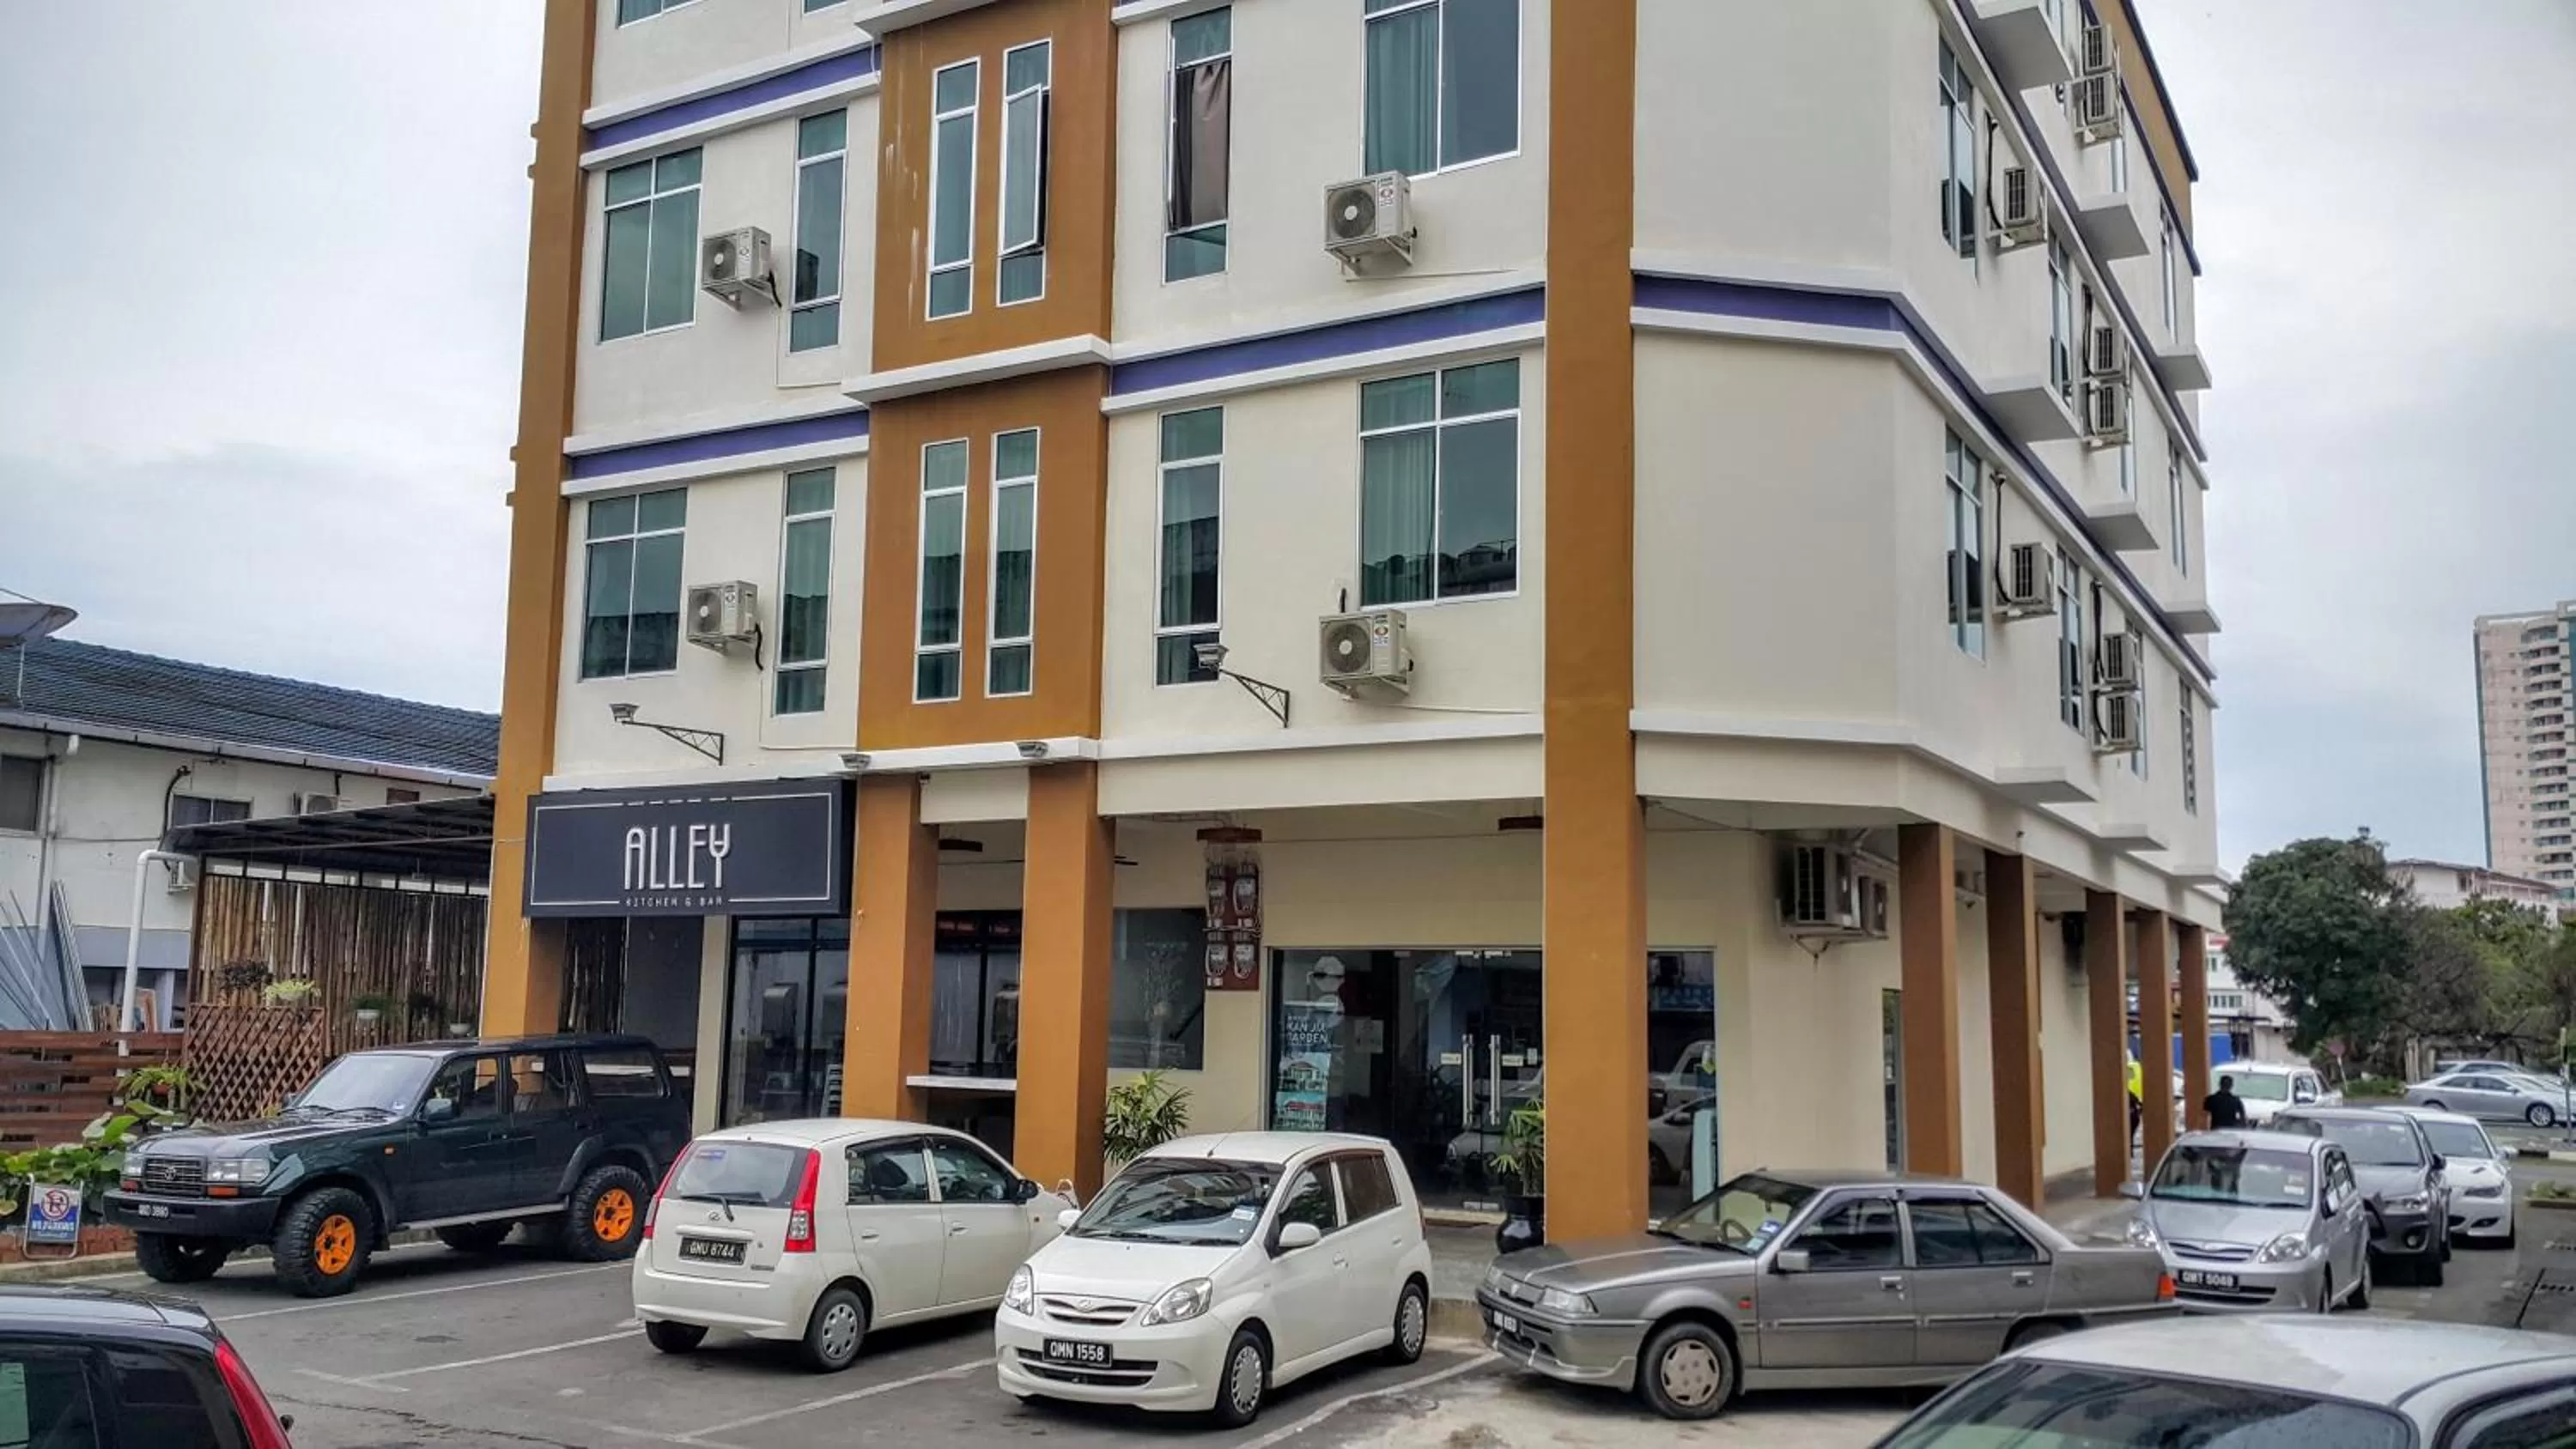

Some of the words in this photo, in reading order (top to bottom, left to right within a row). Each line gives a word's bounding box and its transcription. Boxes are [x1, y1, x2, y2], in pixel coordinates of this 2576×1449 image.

[624, 822, 731, 890] ALLEY
[626, 897, 677, 907] KITCHEN
[700, 895, 722, 906] BAR
[1050, 1341, 1073, 1359] QMN
[1076, 1343, 1105, 1361] 1558
